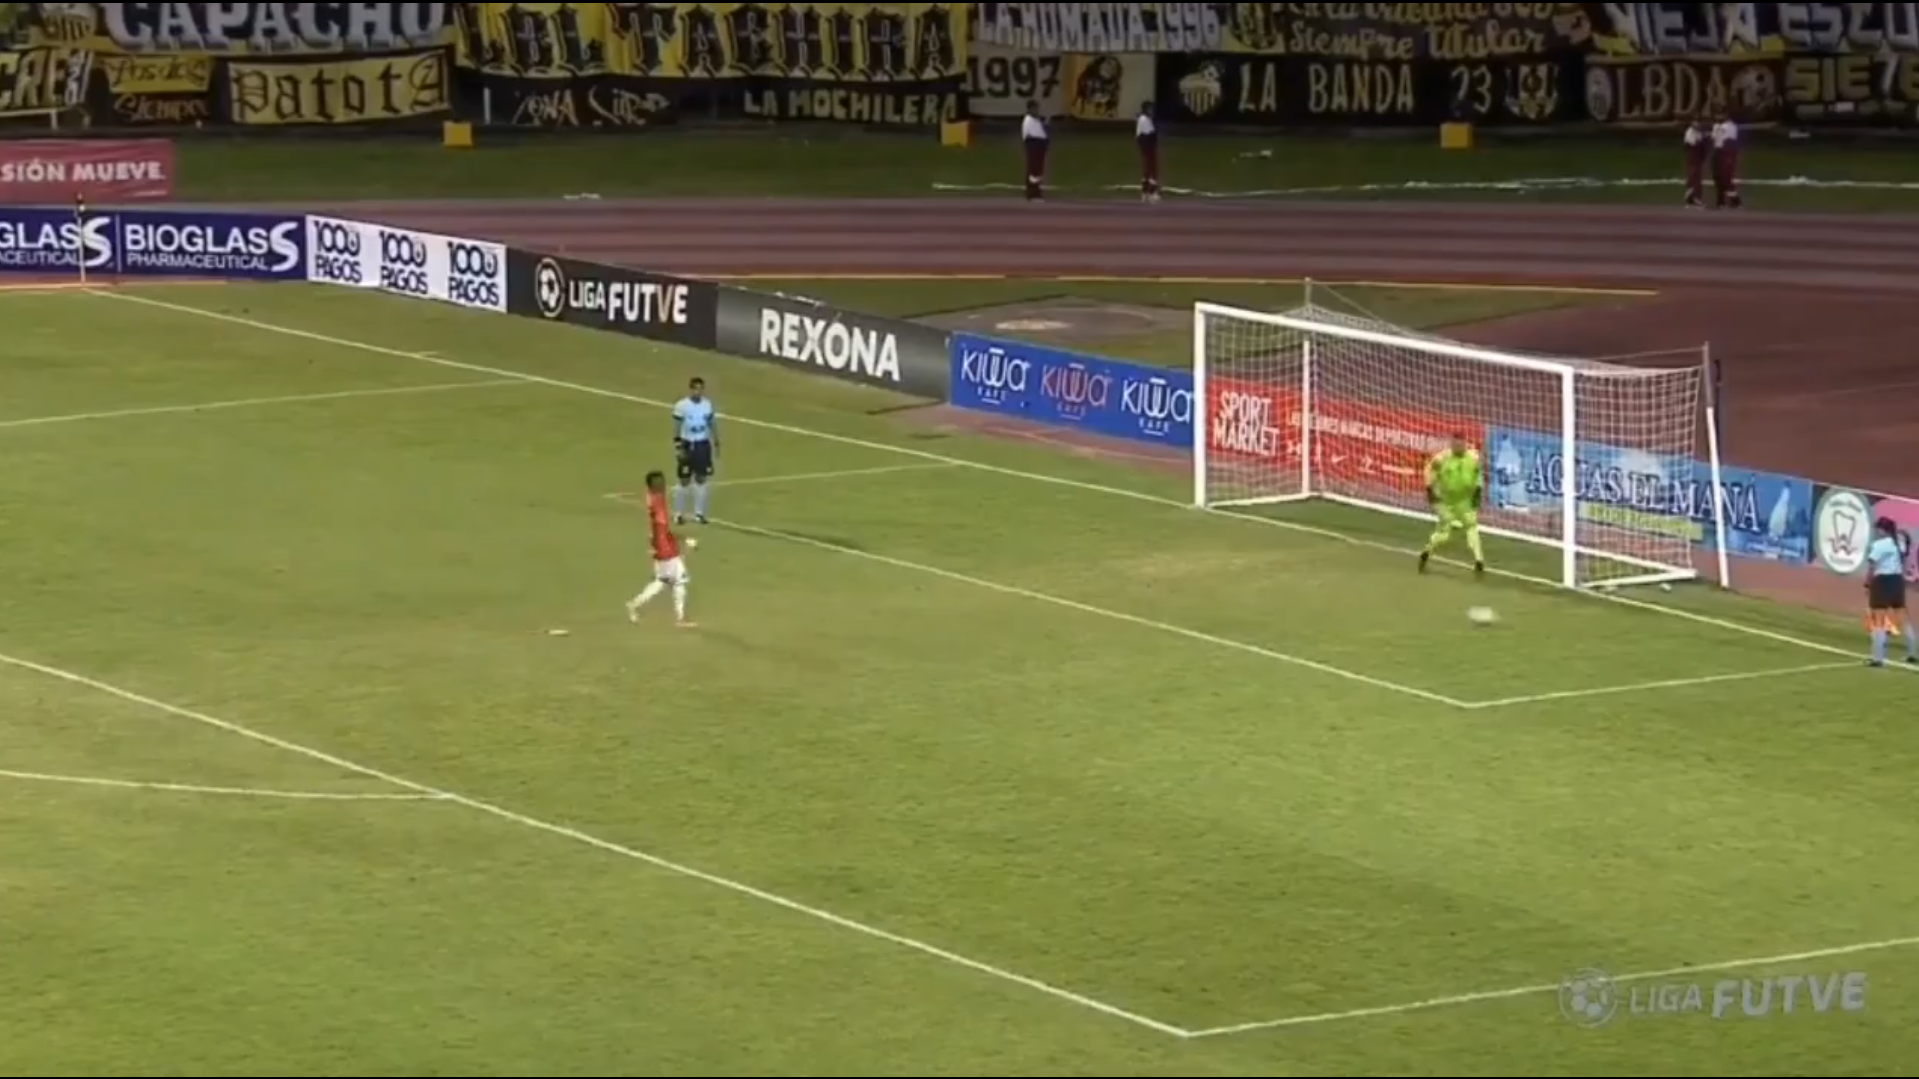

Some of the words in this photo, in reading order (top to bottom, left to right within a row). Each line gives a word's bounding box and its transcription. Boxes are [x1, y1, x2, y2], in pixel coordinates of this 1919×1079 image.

[966, 55, 1060, 98] 1997
[1238, 61, 1277, 113] LA
[1308, 61, 1414, 115] BANDA
[743, 88, 779, 117] LA
[125, 221, 299, 272] BIOGLASS
[127, 250, 269, 271] PHARMACEUTICAL
[315, 255, 362, 284] PAGOS
[380, 265, 428, 294] PAGOS
[449, 276, 499, 306] PAGOS
[569, 280, 606, 310] LIGA
[608, 282, 688, 324] FUTVE
[760, 307, 900, 381] REXONA
[1220, 390, 1272, 428] SPORT
[1213, 417, 1280, 457] MARKET
[1627, 470, 1665, 510] EL
